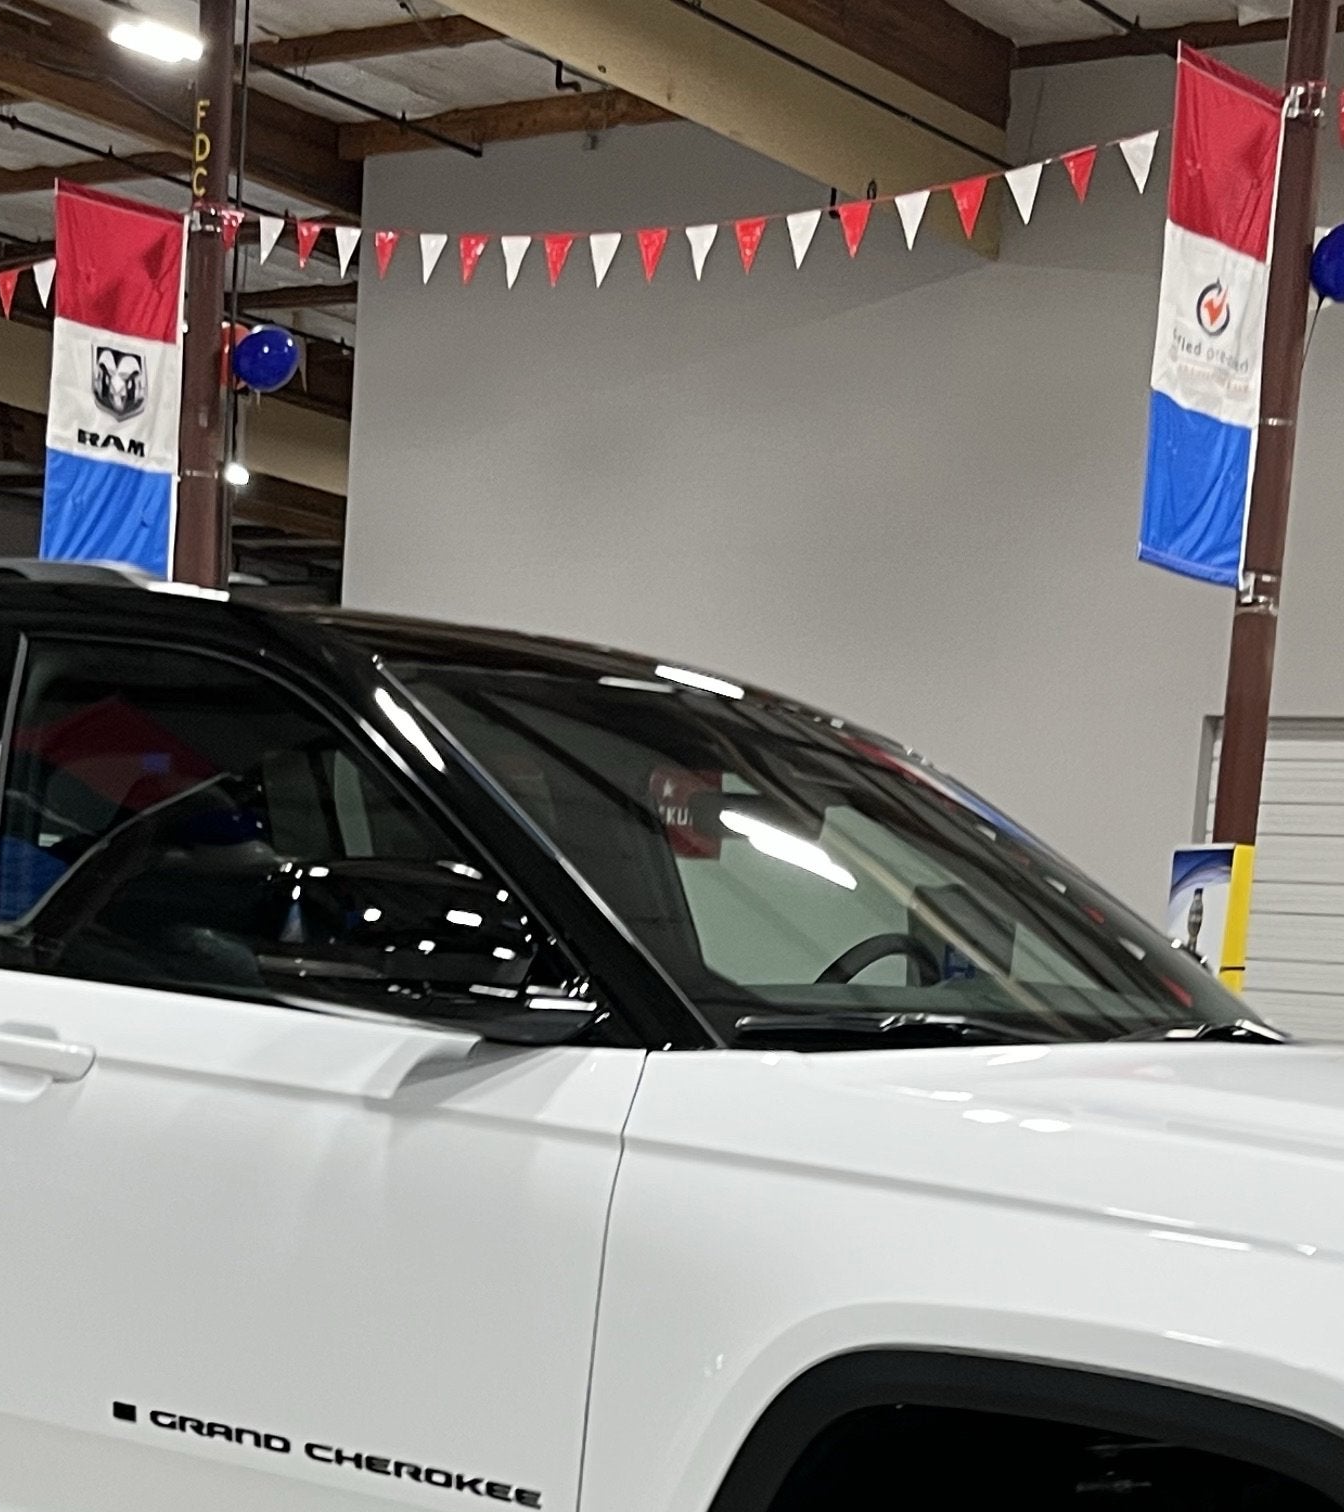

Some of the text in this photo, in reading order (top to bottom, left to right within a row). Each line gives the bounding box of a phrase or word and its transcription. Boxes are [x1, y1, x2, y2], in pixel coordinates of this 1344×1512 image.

[193, 99, 211, 197] FDC
[77, 428, 145, 458] RAM
[149, 1409, 543, 1510] GRAND CHEROKEE
